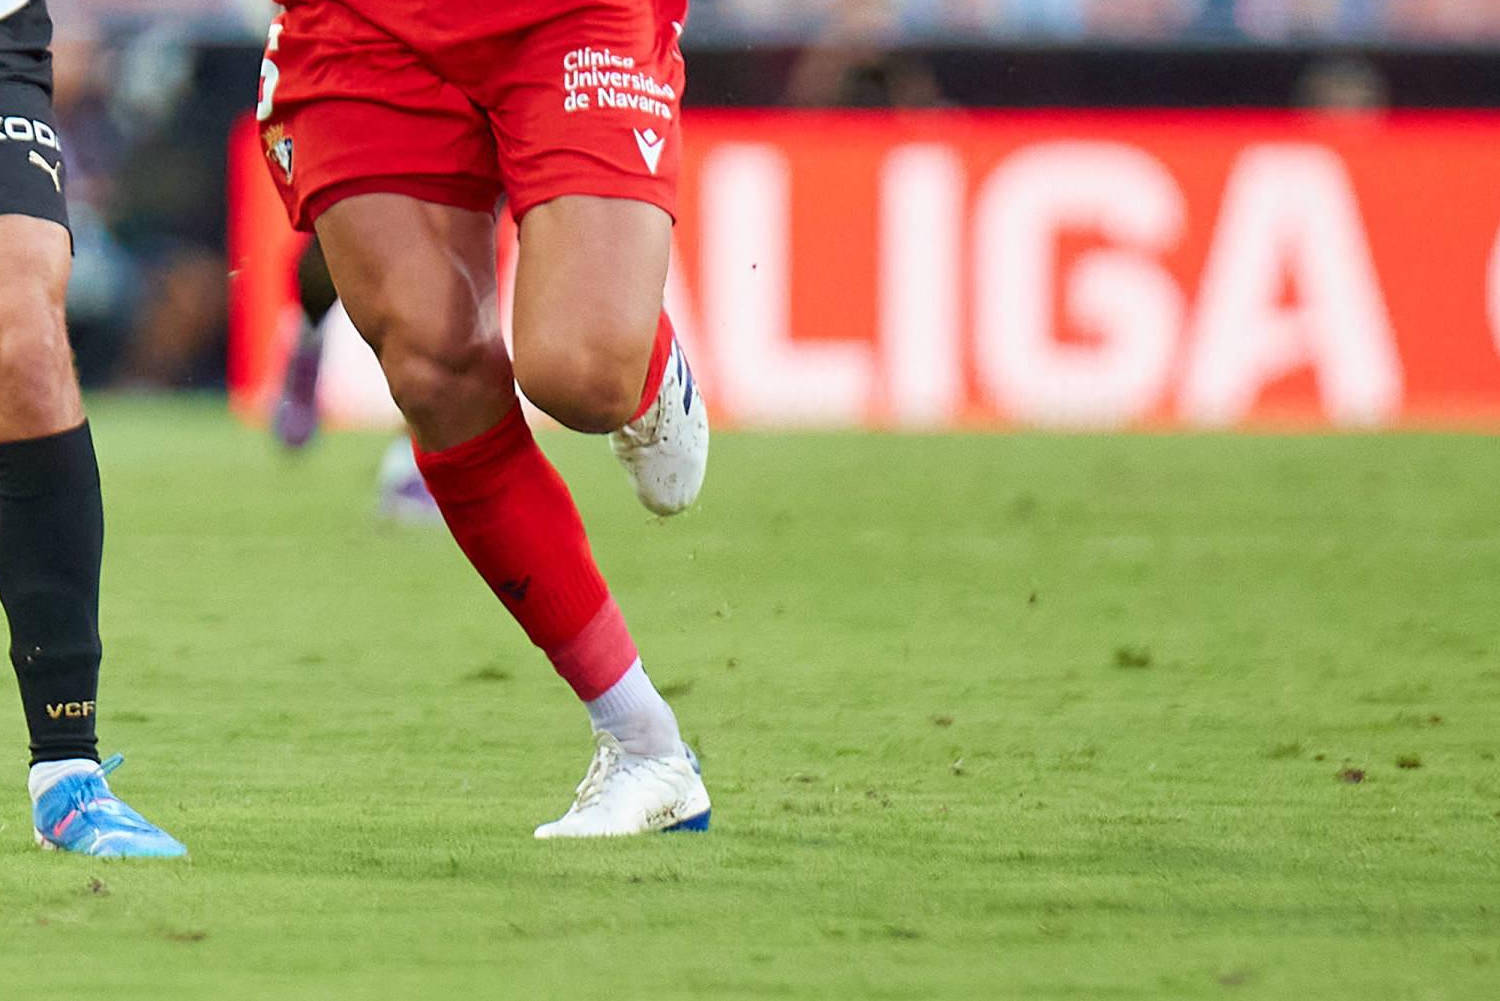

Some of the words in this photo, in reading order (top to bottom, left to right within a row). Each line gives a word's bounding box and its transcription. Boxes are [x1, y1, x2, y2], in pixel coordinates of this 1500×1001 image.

[564, 89, 590, 112] de
[598, 87, 673, 119] Navarra
[655, 140, 1407, 430] LIGA
[46, 701, 96, 719] VCF
